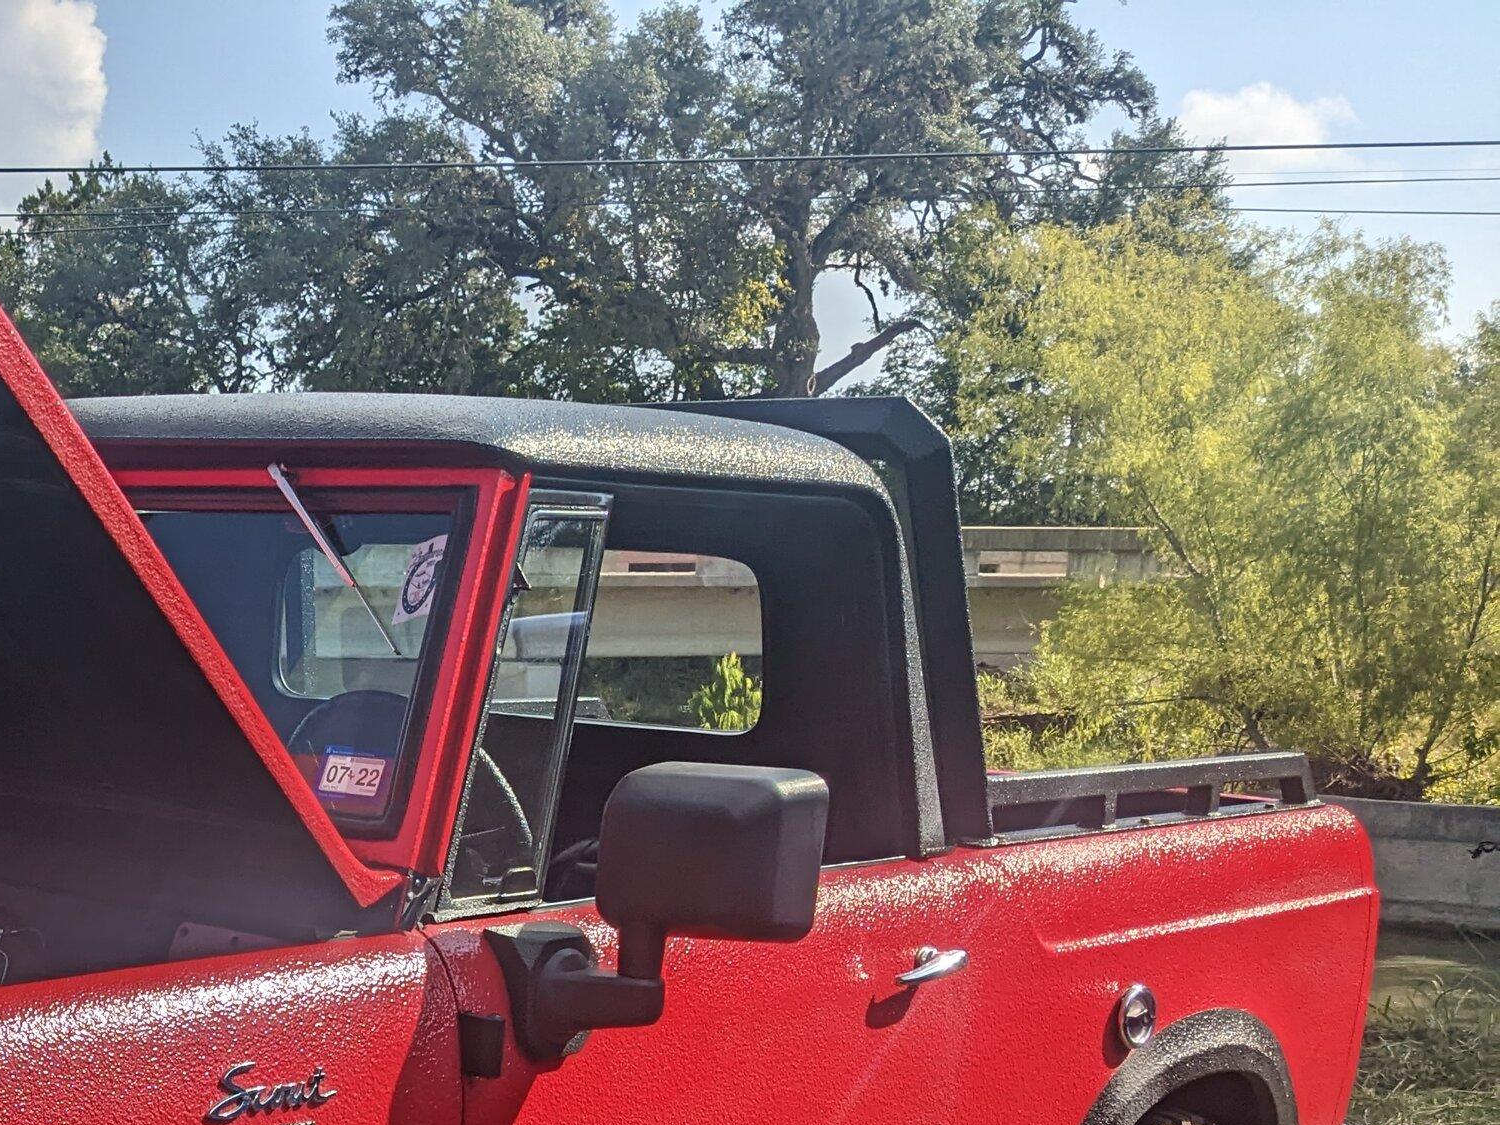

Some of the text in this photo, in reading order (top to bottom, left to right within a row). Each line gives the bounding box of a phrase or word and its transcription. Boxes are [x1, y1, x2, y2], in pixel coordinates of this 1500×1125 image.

[326, 765, 379, 787] 07 22
[208, 1061, 338, 1121] Scout
